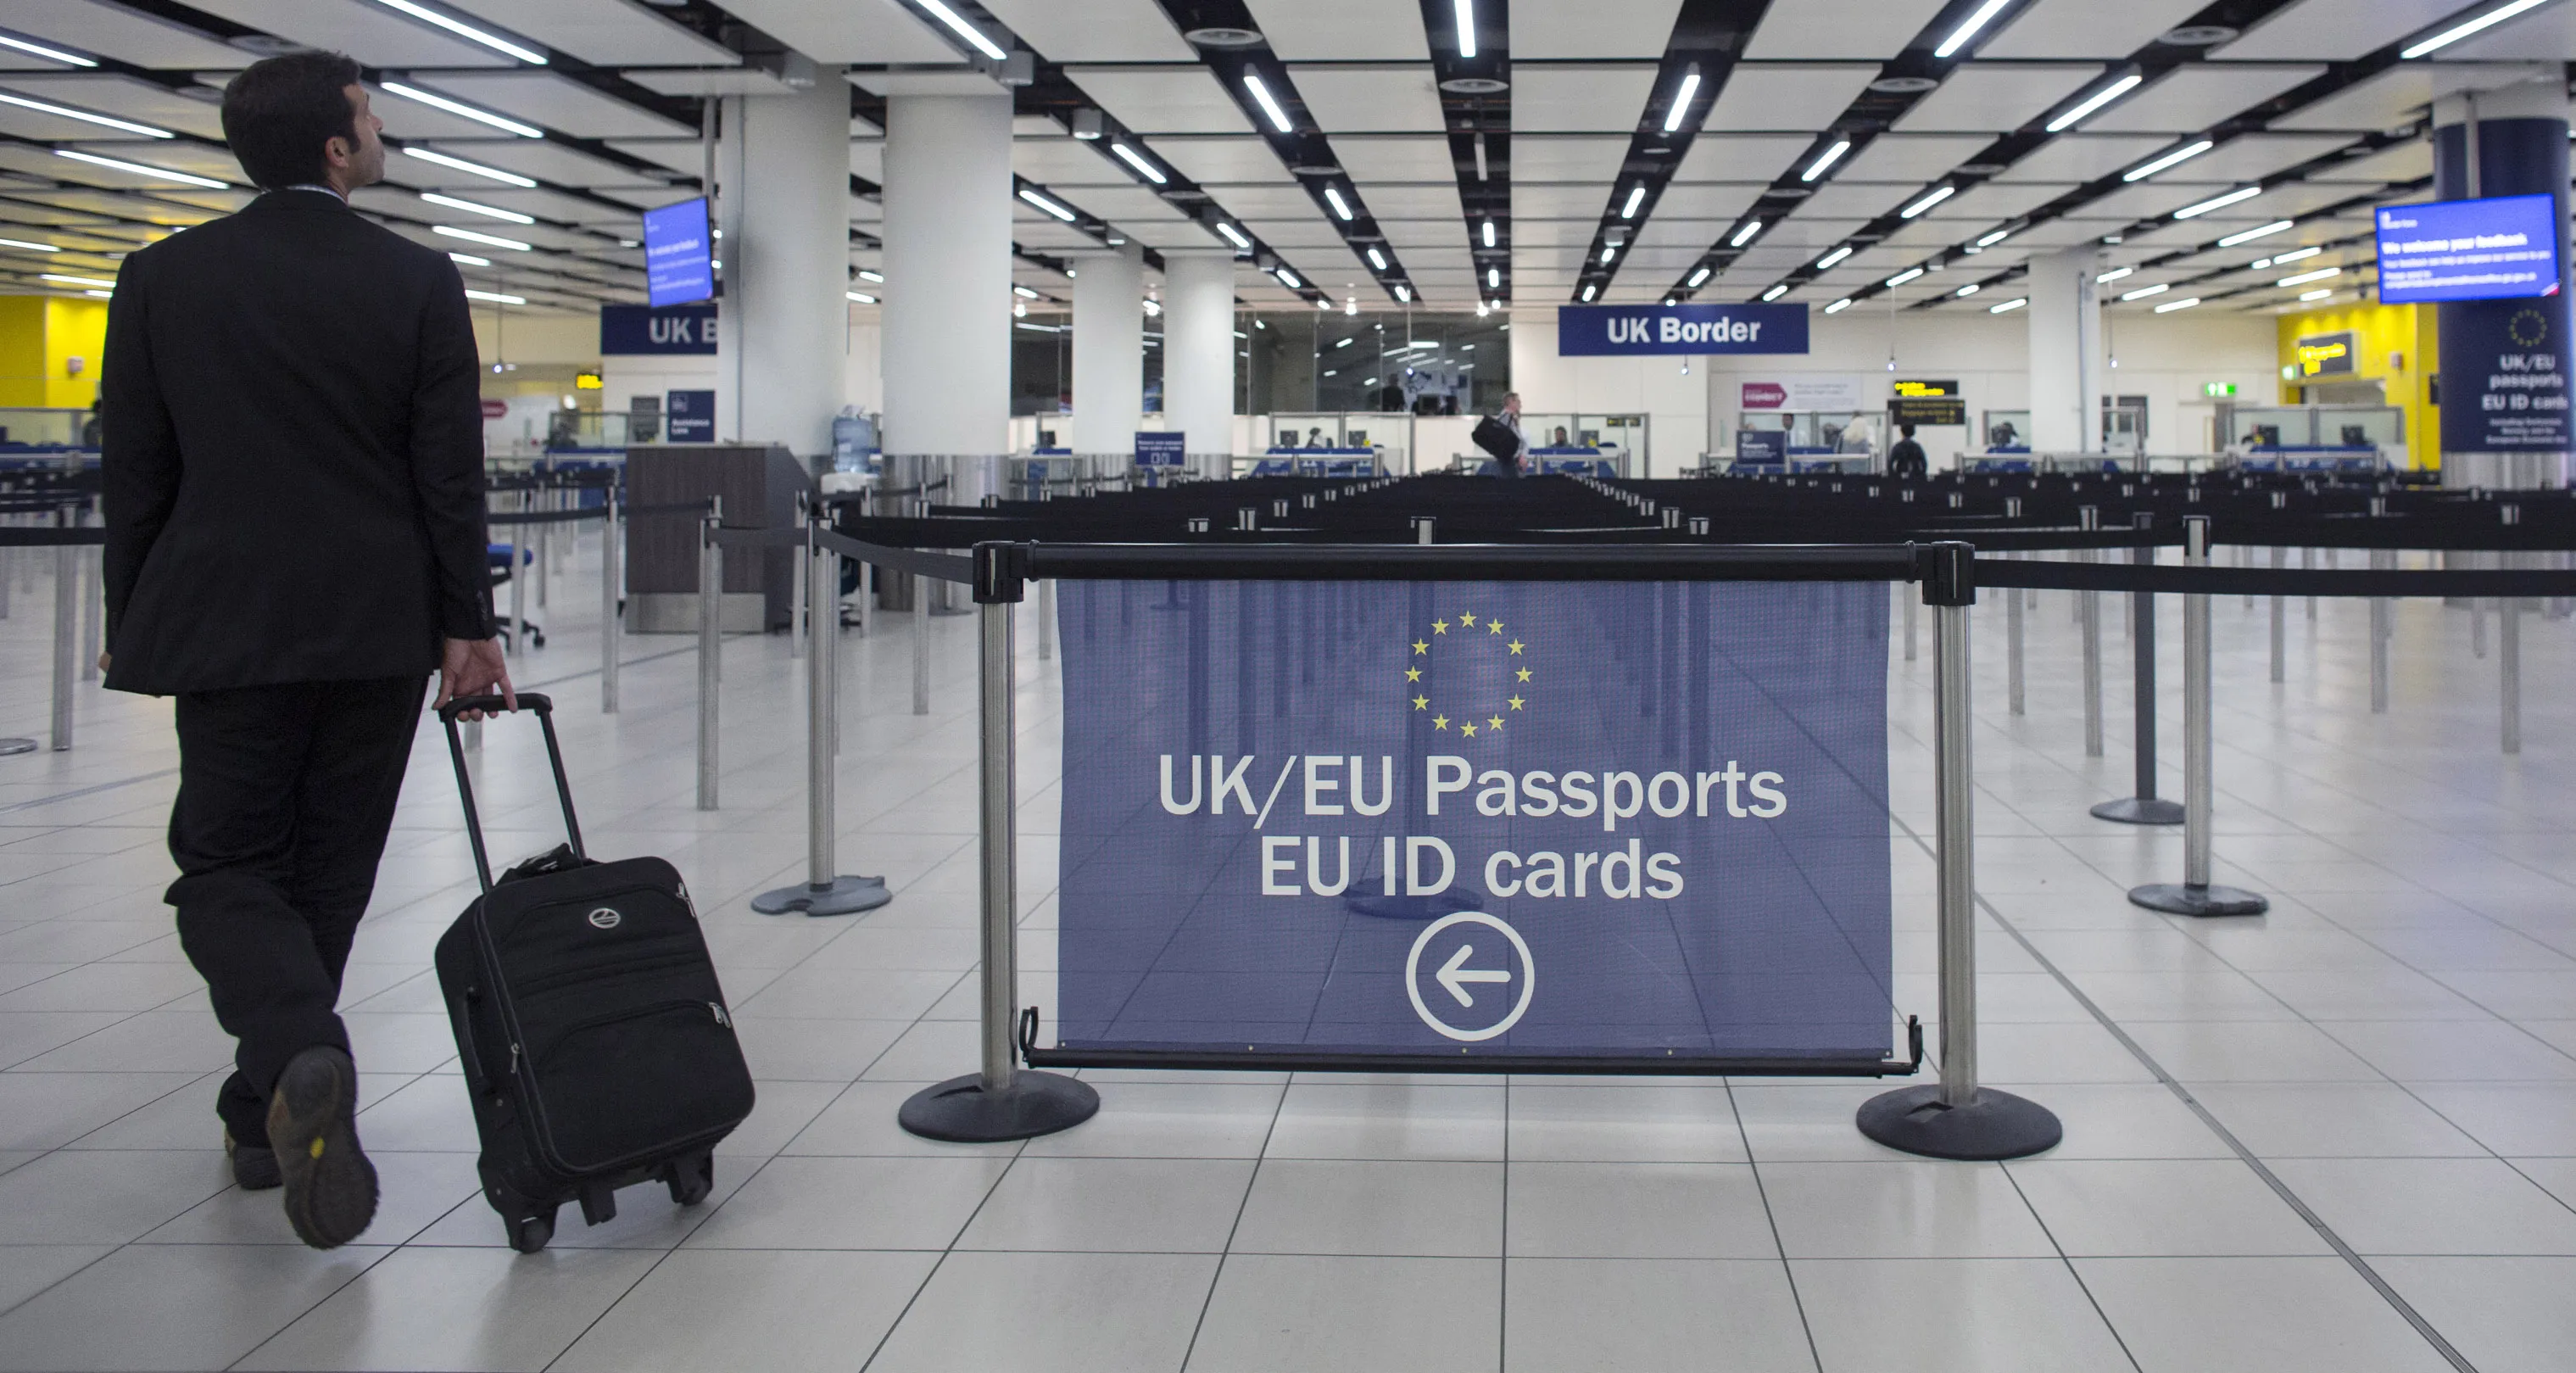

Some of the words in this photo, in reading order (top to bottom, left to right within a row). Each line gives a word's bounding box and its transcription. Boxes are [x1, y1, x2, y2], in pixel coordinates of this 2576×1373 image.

[649, 316, 694, 344] UK
[1608, 317, 1651, 343] UK
[1659, 315, 1761, 343] Border
[2500, 353, 2556, 373] UK/EU
[2481, 393, 2506, 410] EU
[2510, 393, 2530, 410] ID
[1159, 753, 1393, 829] UK/EU
[1426, 755, 1788, 832] Passports
[1261, 835, 1351, 897] EU
[1384, 836, 1457, 897] ID
[1484, 837, 1685, 900] cards
